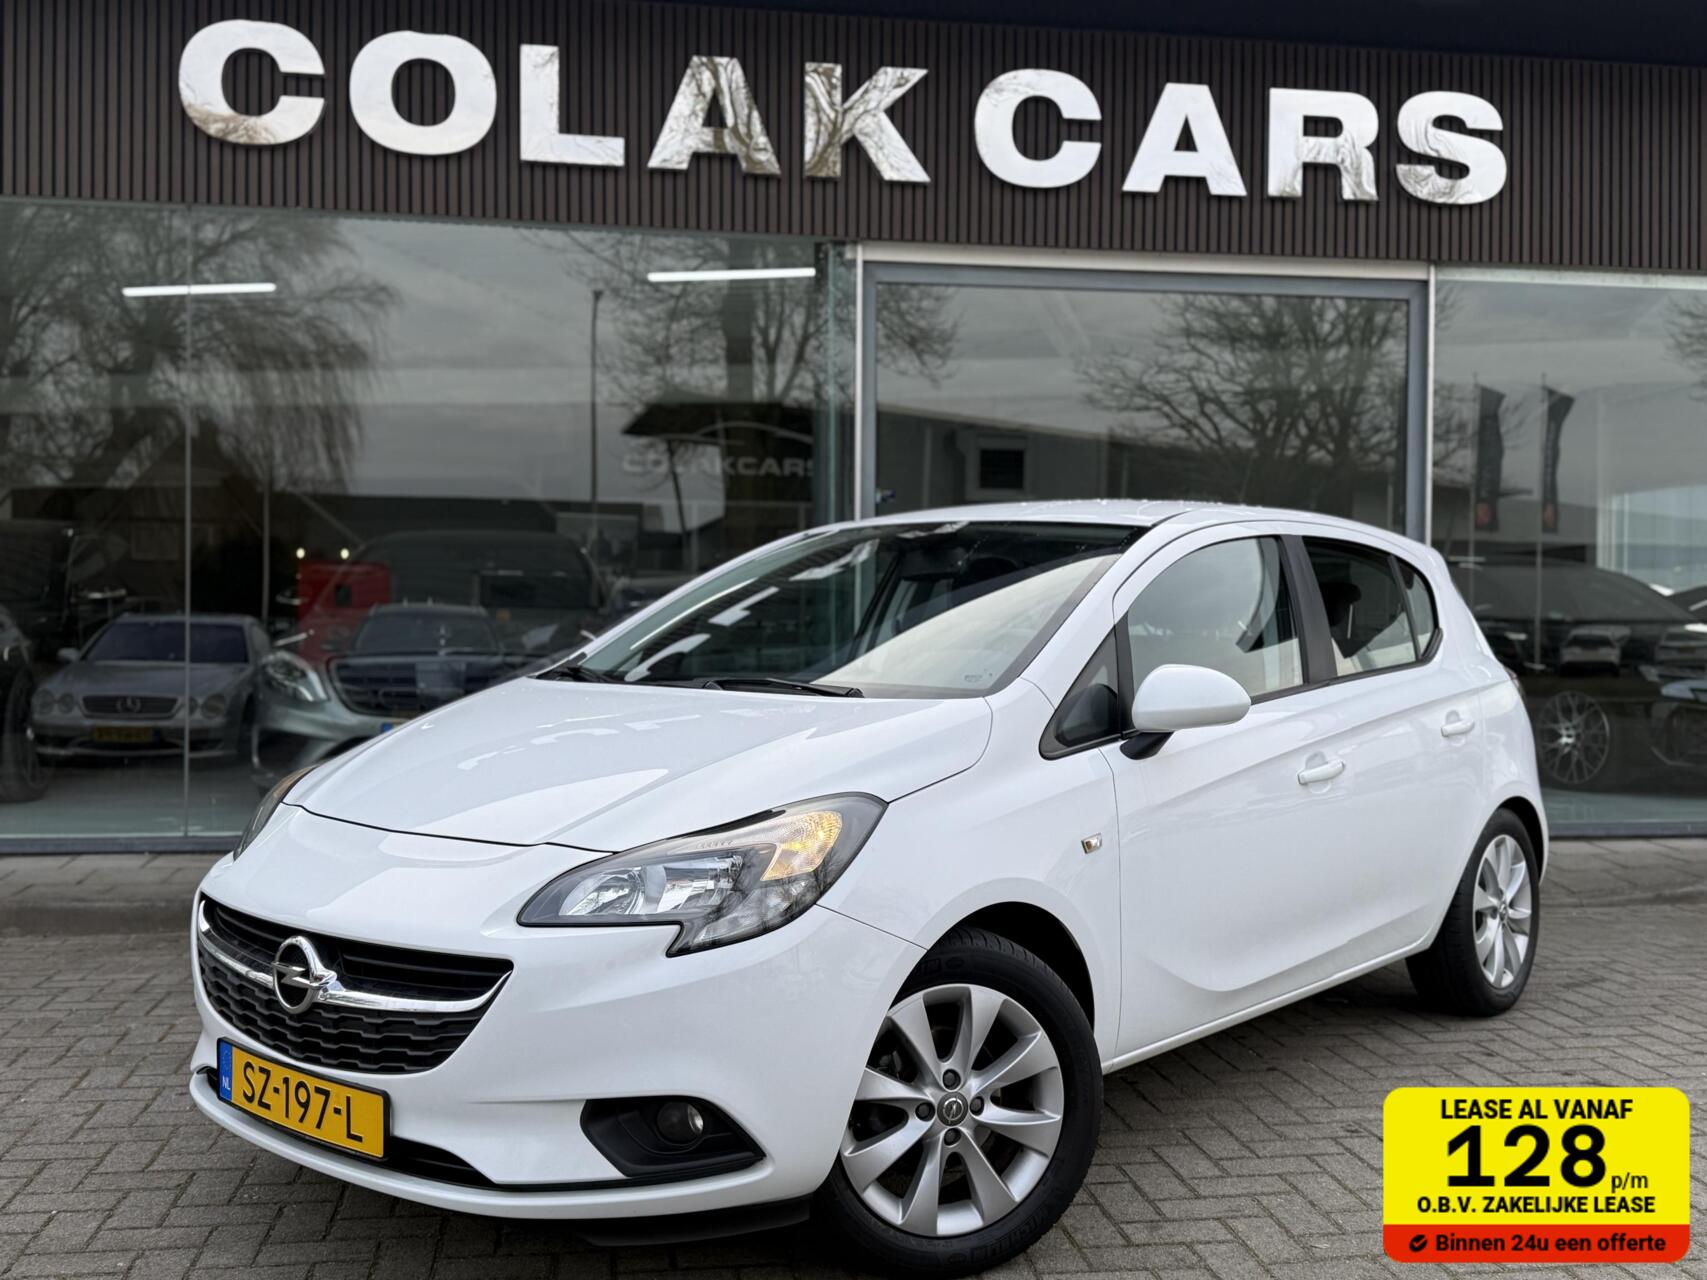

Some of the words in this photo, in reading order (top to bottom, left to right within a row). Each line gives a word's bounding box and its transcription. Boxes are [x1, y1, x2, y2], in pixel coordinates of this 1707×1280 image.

[178, 19, 931, 184] COLAK
[975, 68, 1509, 206] CARS
[222, 1076, 231, 1091] NL
[242, 1061, 363, 1143] SZ-197-L
